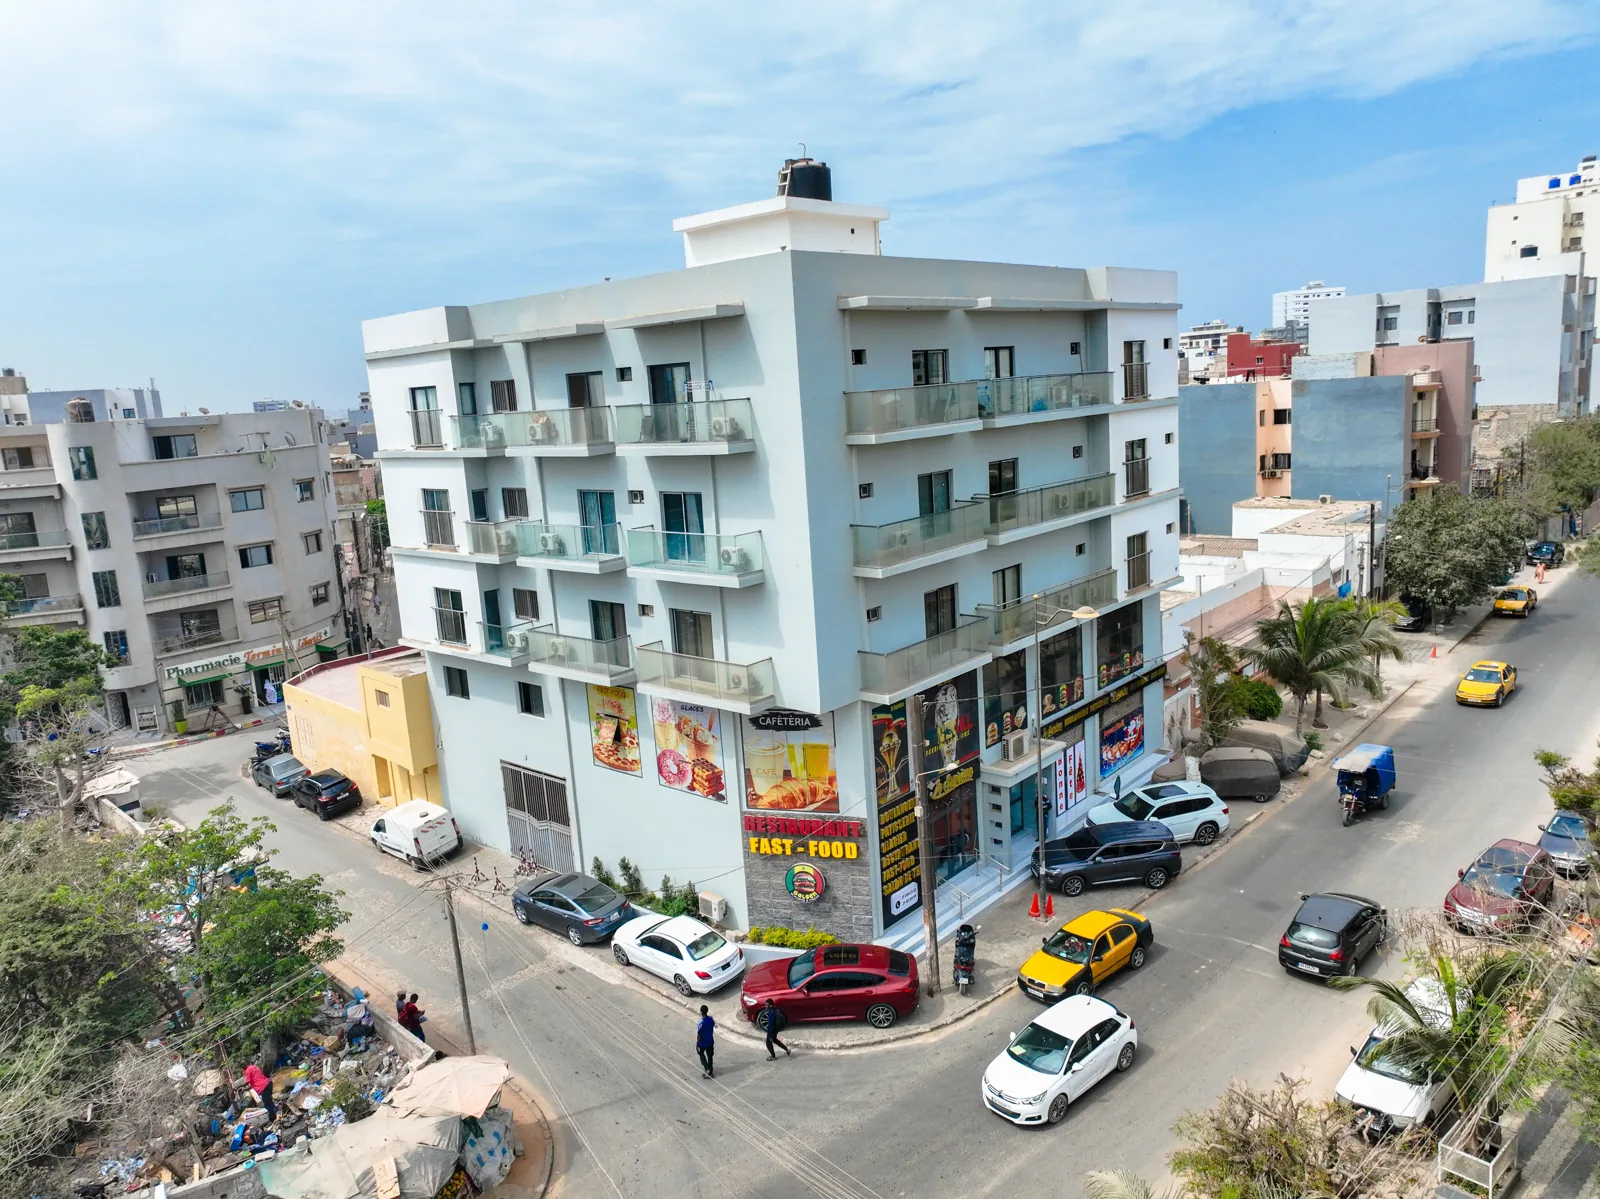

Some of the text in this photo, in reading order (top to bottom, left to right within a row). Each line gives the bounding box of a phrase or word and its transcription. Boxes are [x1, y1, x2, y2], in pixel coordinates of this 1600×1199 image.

[165, 655, 240, 679] Pharmacie
[680, 704, 704, 713] GLACES
[759, 715, 811, 726] CAFÉTÉRIA
[743, 814, 861, 838] RESTAURANT
[749, 837, 793, 856] FAST
[808, 840, 857, 859] FOOD
